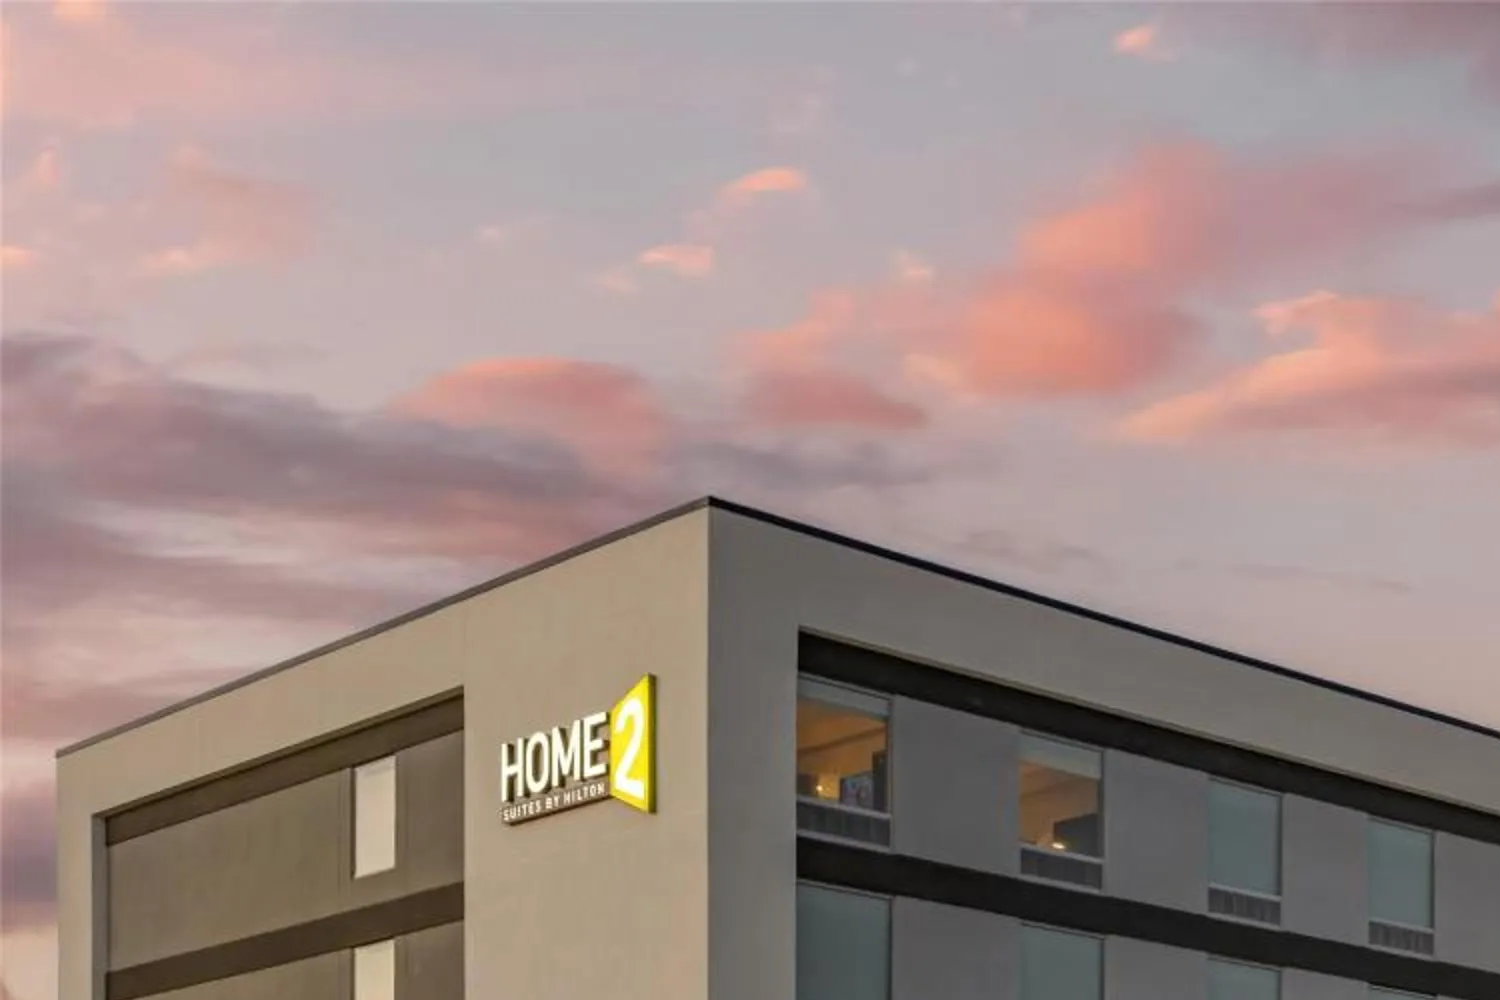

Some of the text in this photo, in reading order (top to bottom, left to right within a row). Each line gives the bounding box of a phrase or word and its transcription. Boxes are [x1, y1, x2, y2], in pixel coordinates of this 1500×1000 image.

[501, 696, 645, 803] HOME 2
[503, 782, 605, 821] SUITES BY HILTON
